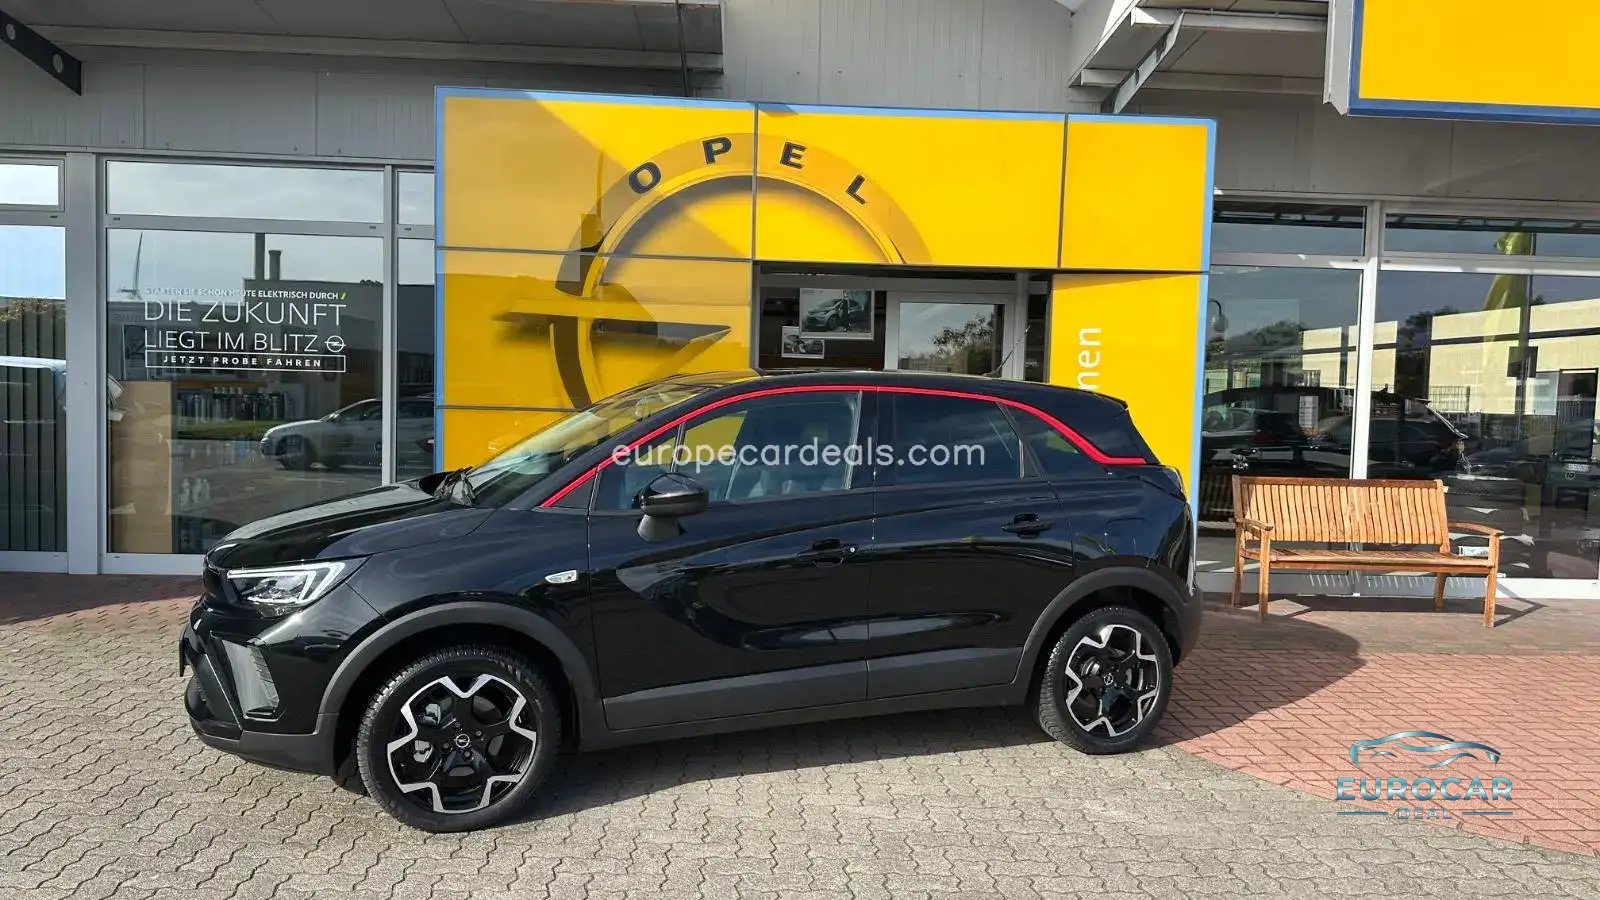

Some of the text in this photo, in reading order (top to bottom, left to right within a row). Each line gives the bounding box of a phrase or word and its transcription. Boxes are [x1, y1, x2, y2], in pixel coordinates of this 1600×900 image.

[628, 136, 867, 205] OPEL
[258, 290, 308, 299] ELEKTRISCH
[309, 291, 339, 300] DURCH
[144, 300, 347, 326] DIE ZUKUNFT
[144, 329, 318, 352] LIEGT IM BLITZ
[163, 355, 322, 367] JETZT PROBE FAHREN
